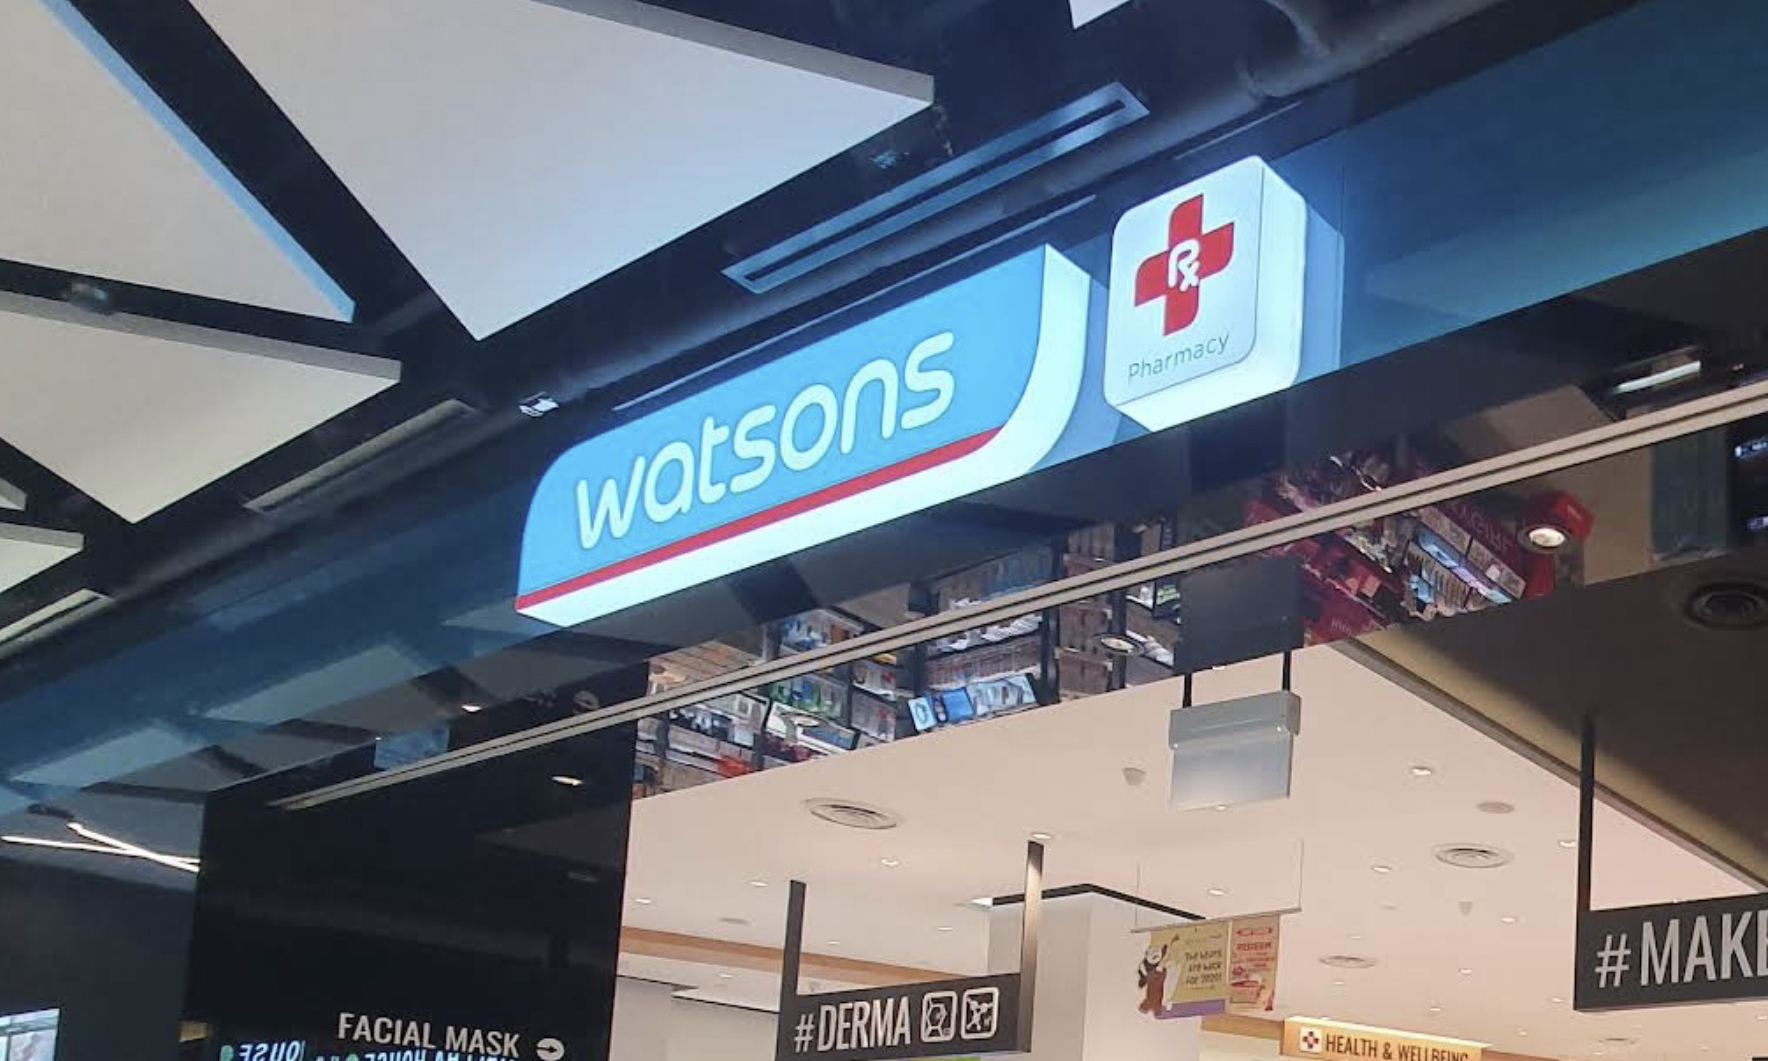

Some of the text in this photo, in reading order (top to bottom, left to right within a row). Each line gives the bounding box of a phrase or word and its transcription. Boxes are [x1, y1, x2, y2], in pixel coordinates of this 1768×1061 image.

[1127, 333, 1230, 385] Pharmacy
[575, 331, 954, 550] watsons
[338, 1012, 520, 1058] FACIAL MASK
[1326, 1034, 1377, 1058] HEALTH
[1383, 1042, 1392, 1060] &
